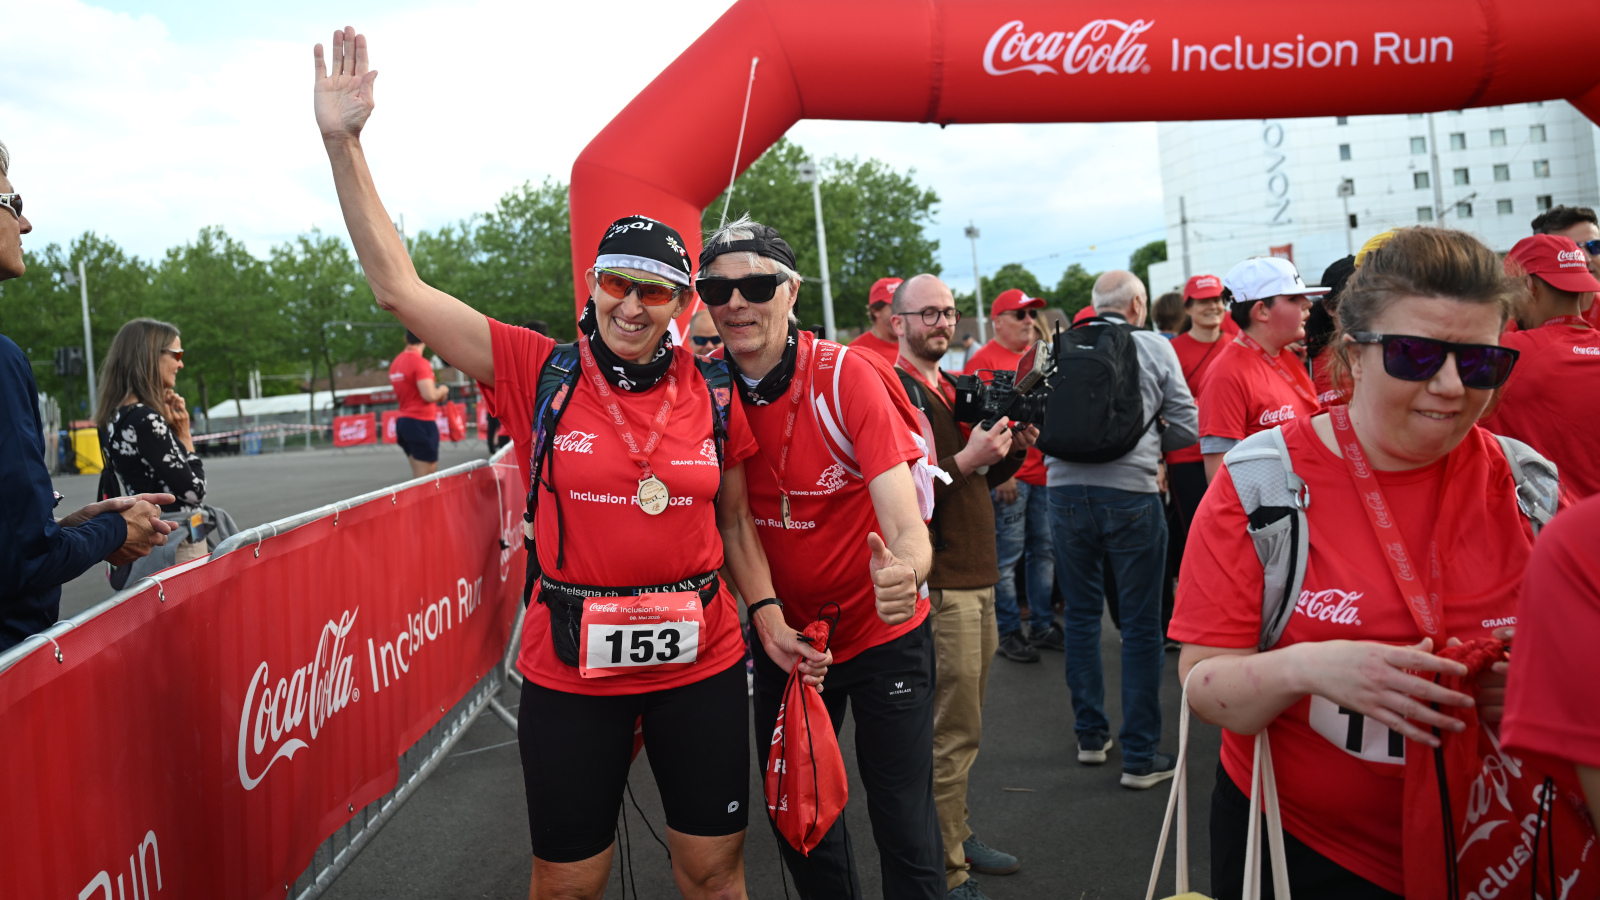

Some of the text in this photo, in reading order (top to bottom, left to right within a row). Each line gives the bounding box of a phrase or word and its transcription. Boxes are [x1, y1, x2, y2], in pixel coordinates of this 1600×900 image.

[983, 19, 1454, 76] Coca-Cola Inclusion Run
[1263, 119, 1293, 227] NOVO
[1259, 405, 1296, 425] Coca-Cola
[553, 430, 599, 454] a-Cola
[570, 490, 627, 505] Inclusion
[668, 496, 694, 506] 026
[788, 521, 815, 529] 2026
[589, 602, 620, 612] Coca-Cola
[1294, 589, 1364, 626] a-Cola
[1482, 616, 1517, 628] GRAND
[605, 629, 681, 664] 153
[238, 605, 360, 791] Coca-Cola
[368, 596, 452, 694] Inclsion
